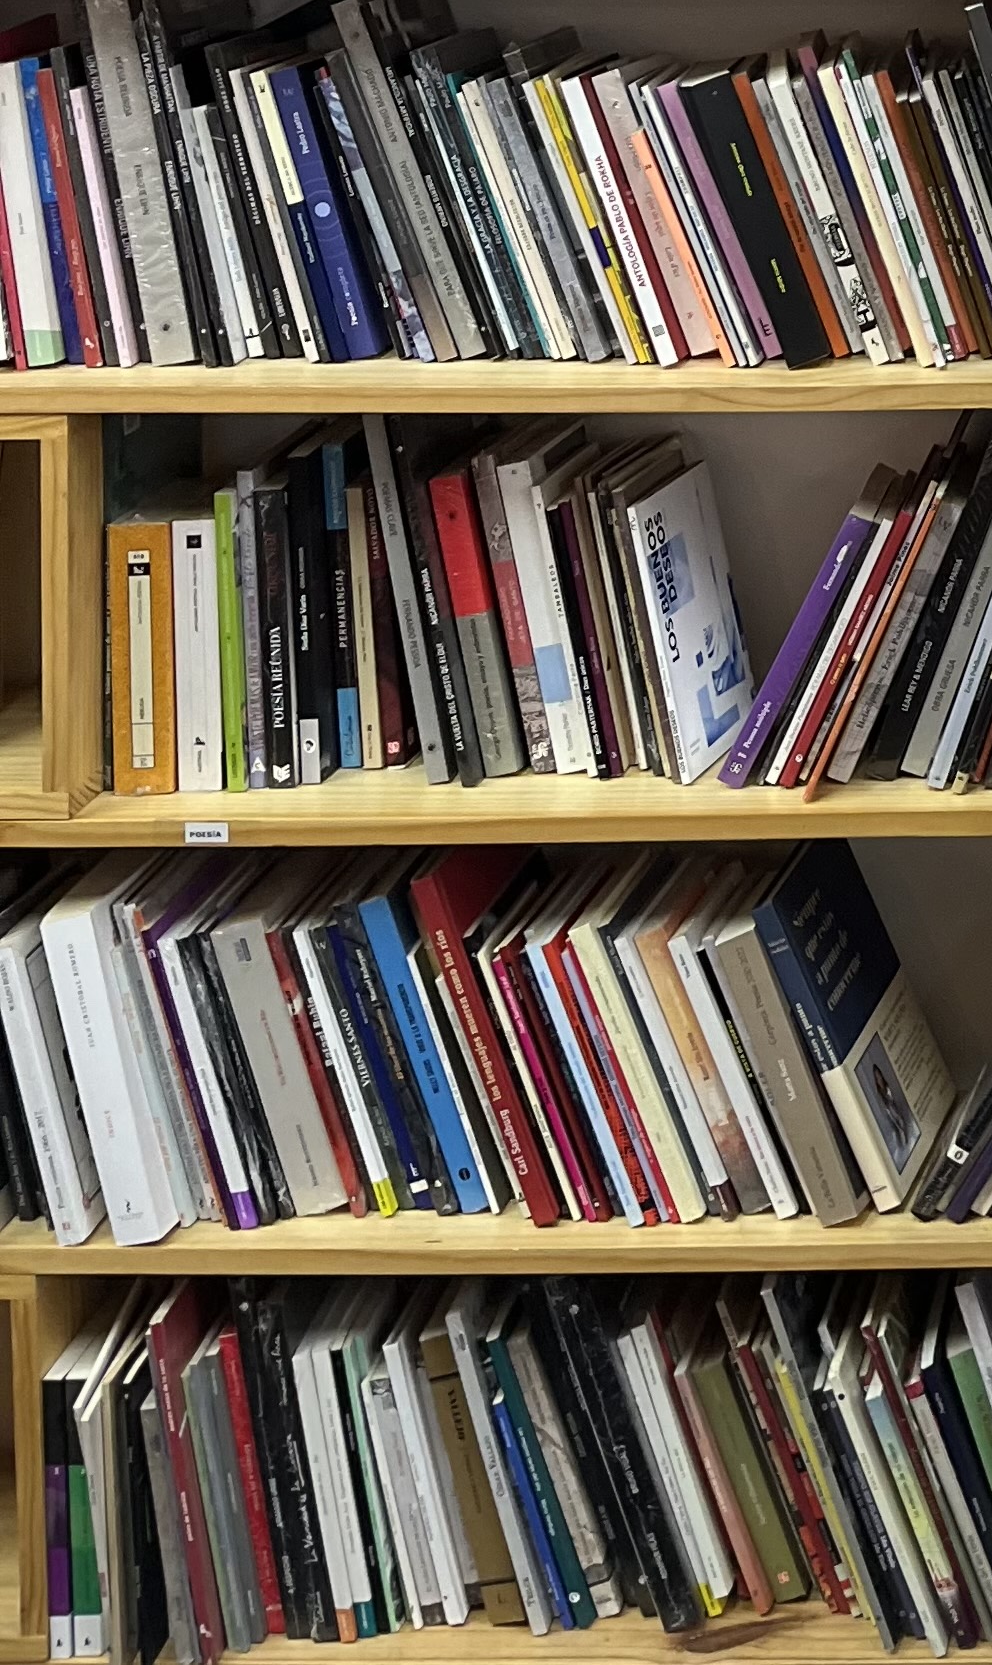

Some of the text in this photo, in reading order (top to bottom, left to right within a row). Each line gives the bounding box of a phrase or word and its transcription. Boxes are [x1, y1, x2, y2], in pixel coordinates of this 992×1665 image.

[643, 516, 682, 662] LOS BUENOS
[652, 510, 679, 602] DESEOS
[334, 569, 348, 648] PERMANENCIAS
[433, 928, 451, 950] ríos
[453, 969, 469, 995] como
[338, 1008, 372, 1087] VIERNES SANTO
[464, 999, 483, 1033] mueren
[475, 1035, 502, 1084] lenguajes
[498, 1109, 529, 1176] Carl Sandburg
